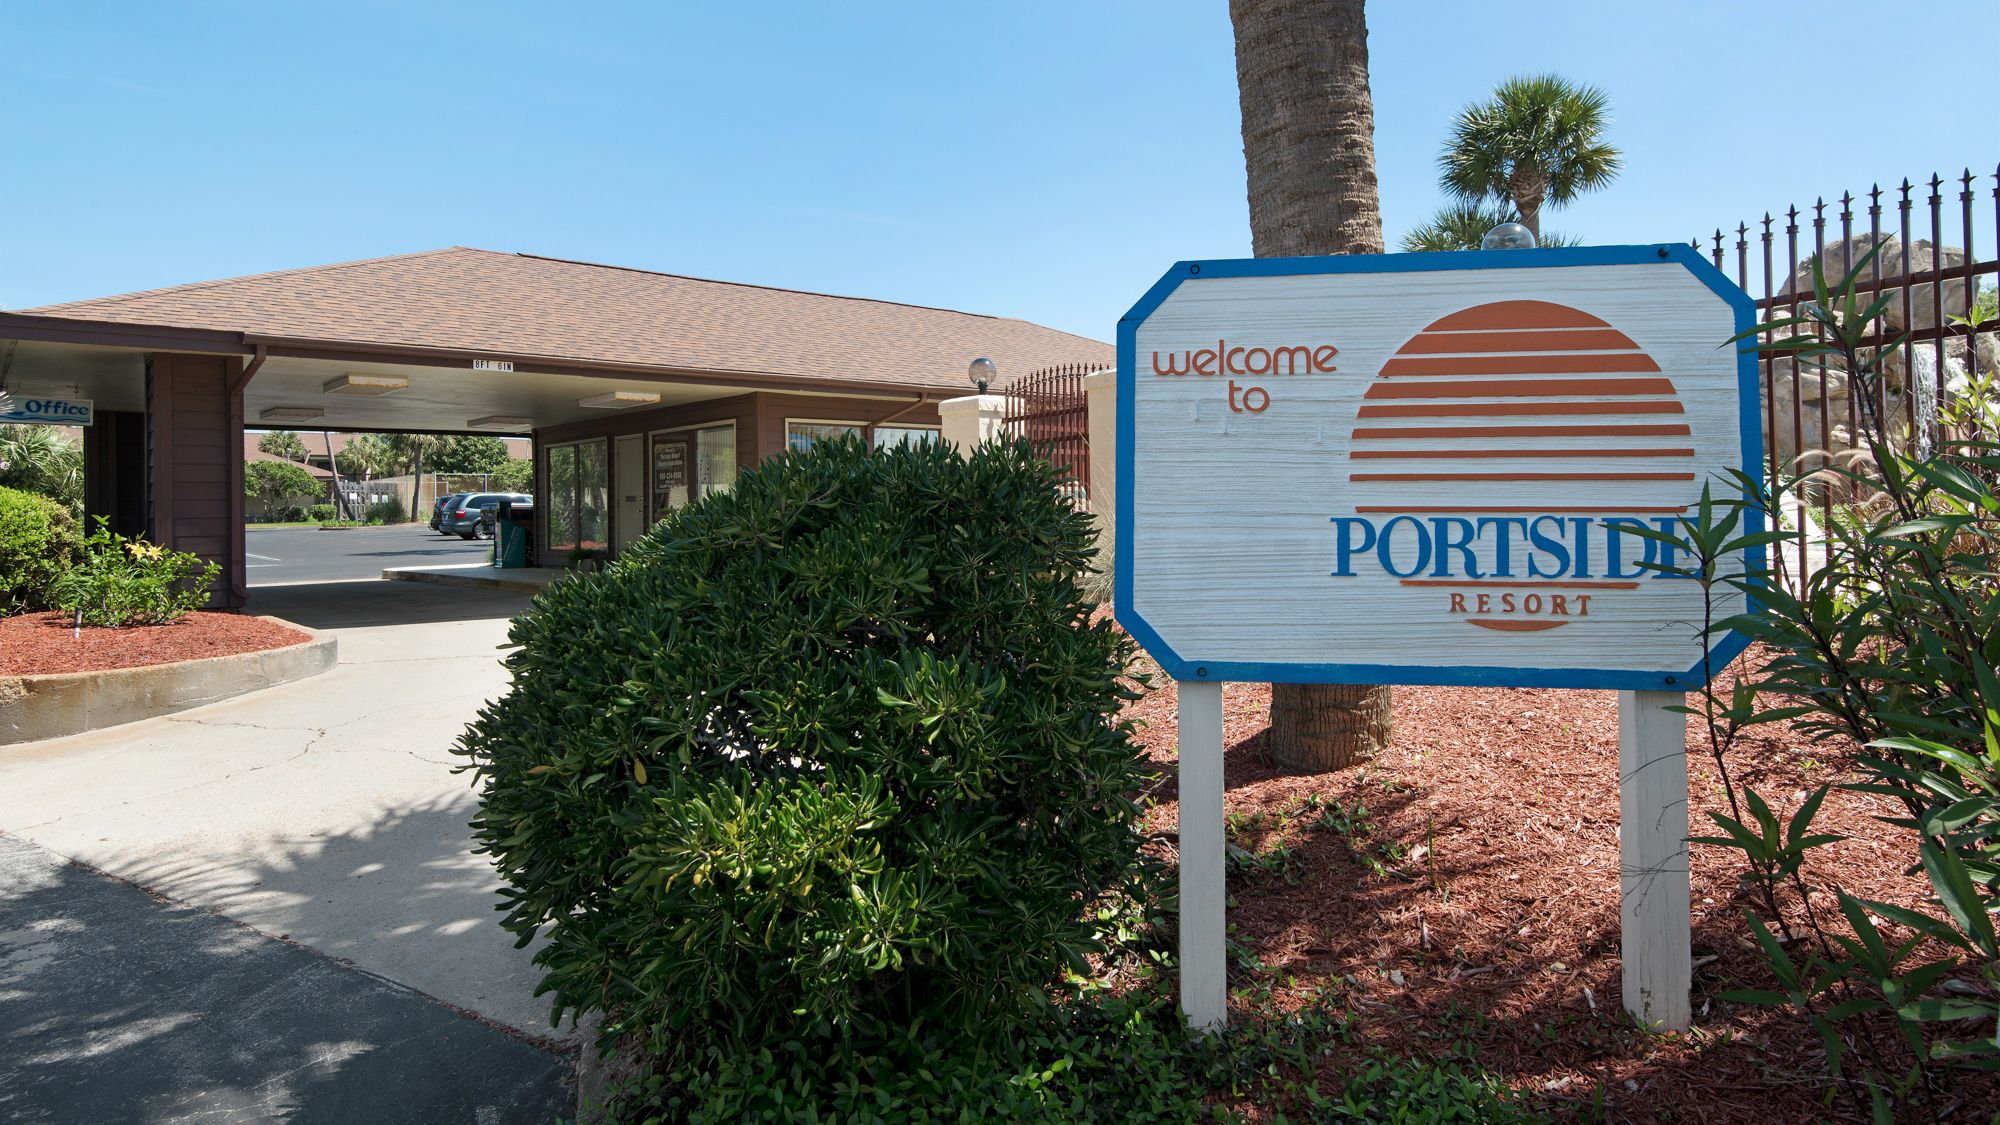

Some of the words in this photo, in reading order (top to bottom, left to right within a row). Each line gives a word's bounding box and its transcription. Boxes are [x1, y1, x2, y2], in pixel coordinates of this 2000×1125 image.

[475, 360, 490, 369] 8FT
[1152, 339, 1339, 376] welcome
[25, 400, 89, 416] Office
[1228, 379, 1270, 413] to
[1330, 515, 1703, 580] PORTSIDE
[1449, 592, 1592, 616] RESORT
